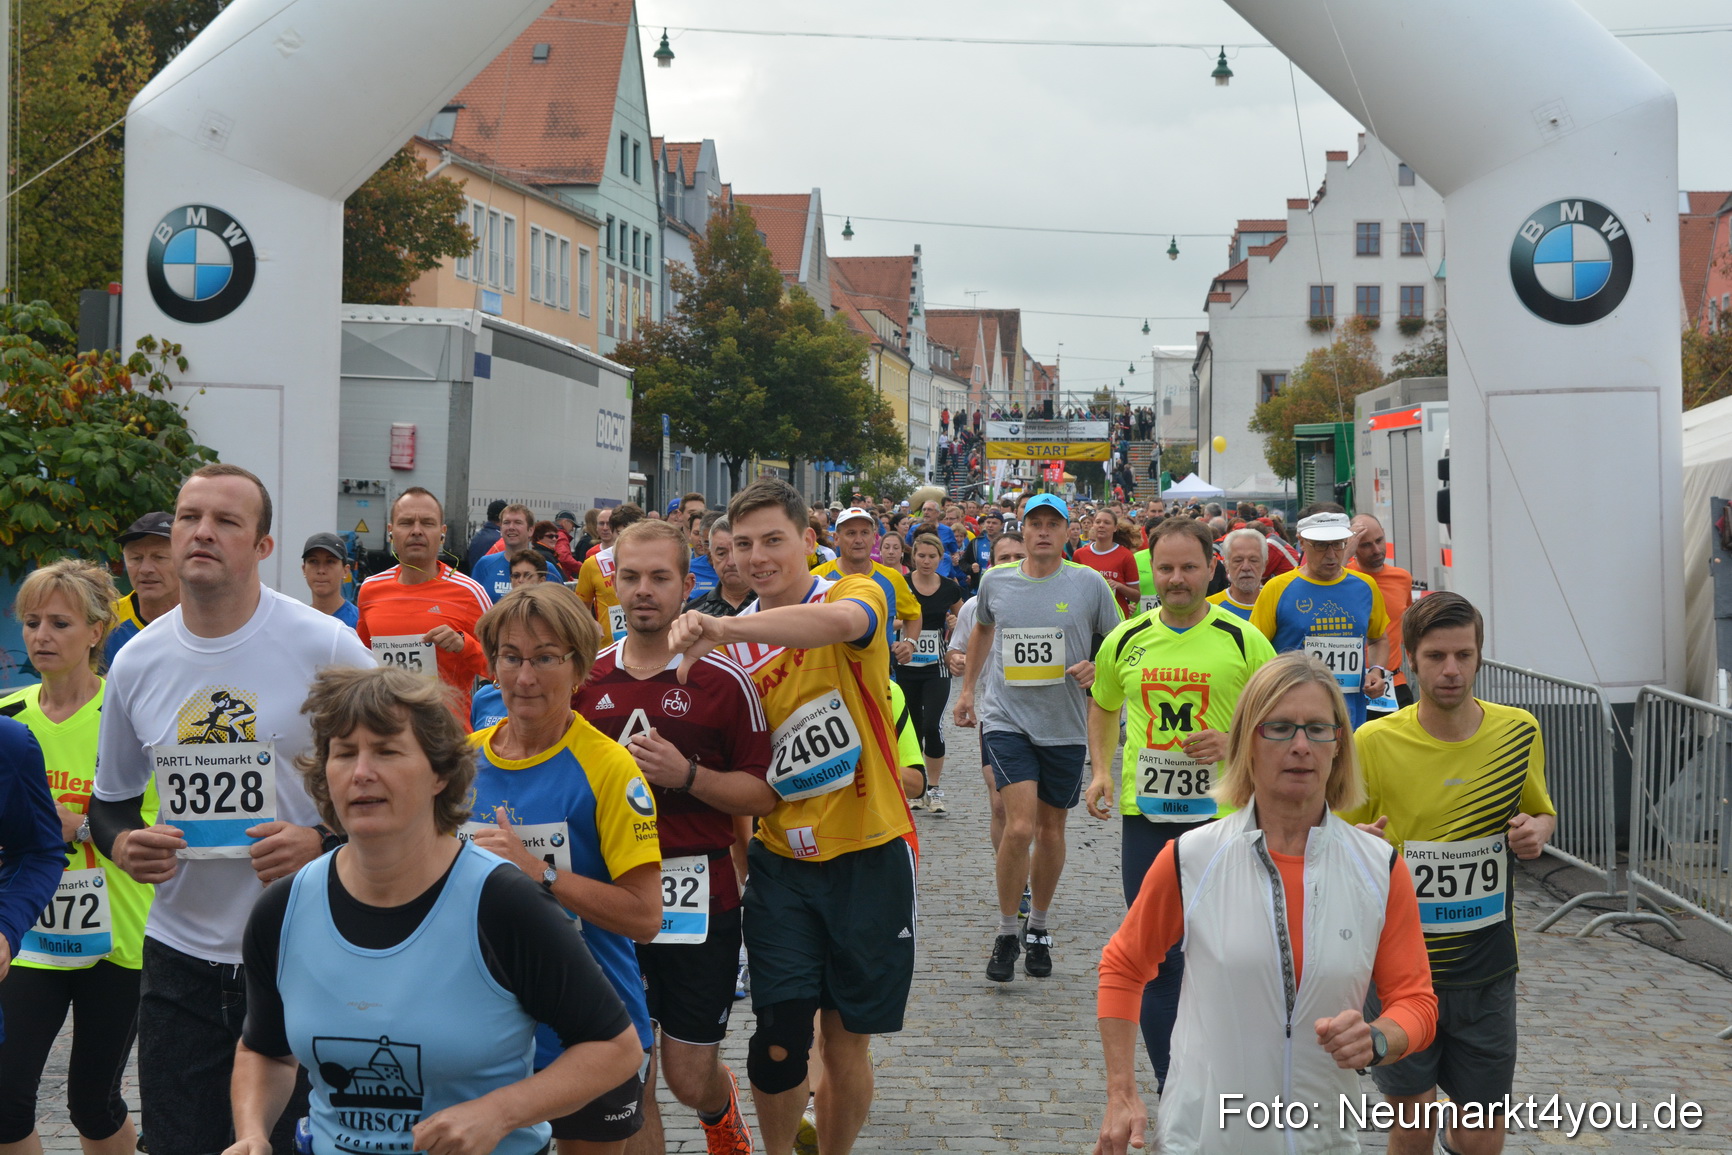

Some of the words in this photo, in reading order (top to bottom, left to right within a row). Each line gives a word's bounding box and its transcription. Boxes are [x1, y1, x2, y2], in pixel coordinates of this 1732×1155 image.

[154, 207, 248, 247] BMW
[1520, 202, 1625, 244] BMW
[596, 408, 625, 452] BOCK
[1026, 445, 1069, 456] START
[391, 641, 422, 649] Neumarkt
[917, 639, 935, 653] 99
[1014, 642, 1053, 664] 653
[1141, 667, 1211, 683] Müller
[595, 702, 615, 710] adidas
[664, 699, 687, 712] FCN
[1158, 702, 1193, 731] M
[772, 734, 793, 751] PARTL
[791, 706, 828, 735] Neumarkt
[775, 716, 850, 778] 2460
[156, 756, 192, 767] PARTL
[195, 754, 252, 766] Neumarkt
[1139, 754, 1162, 765] PARTL
[792, 759, 851, 790] Christoph
[1143, 767, 1210, 796] 2738
[168, 770, 264, 814] 3328
[1163, 802, 1189, 813] Mike
[633, 820, 657, 834] PAR
[522, 837, 545, 848] arkt
[1406, 850, 1439, 860] PARTL
[1441, 847, 1489, 860] Neumarkt
[1414, 858, 1499, 898] 2579
[661, 876, 699, 908] 32
[34, 893, 101, 930] 072
[1435, 905, 1483, 920] Florian
[660, 918, 674, 930] er
[38, 936, 82, 954] Monika
[604, 1109, 631, 1122] JAKO
[336, 1133, 409, 1151] APOTHEK
